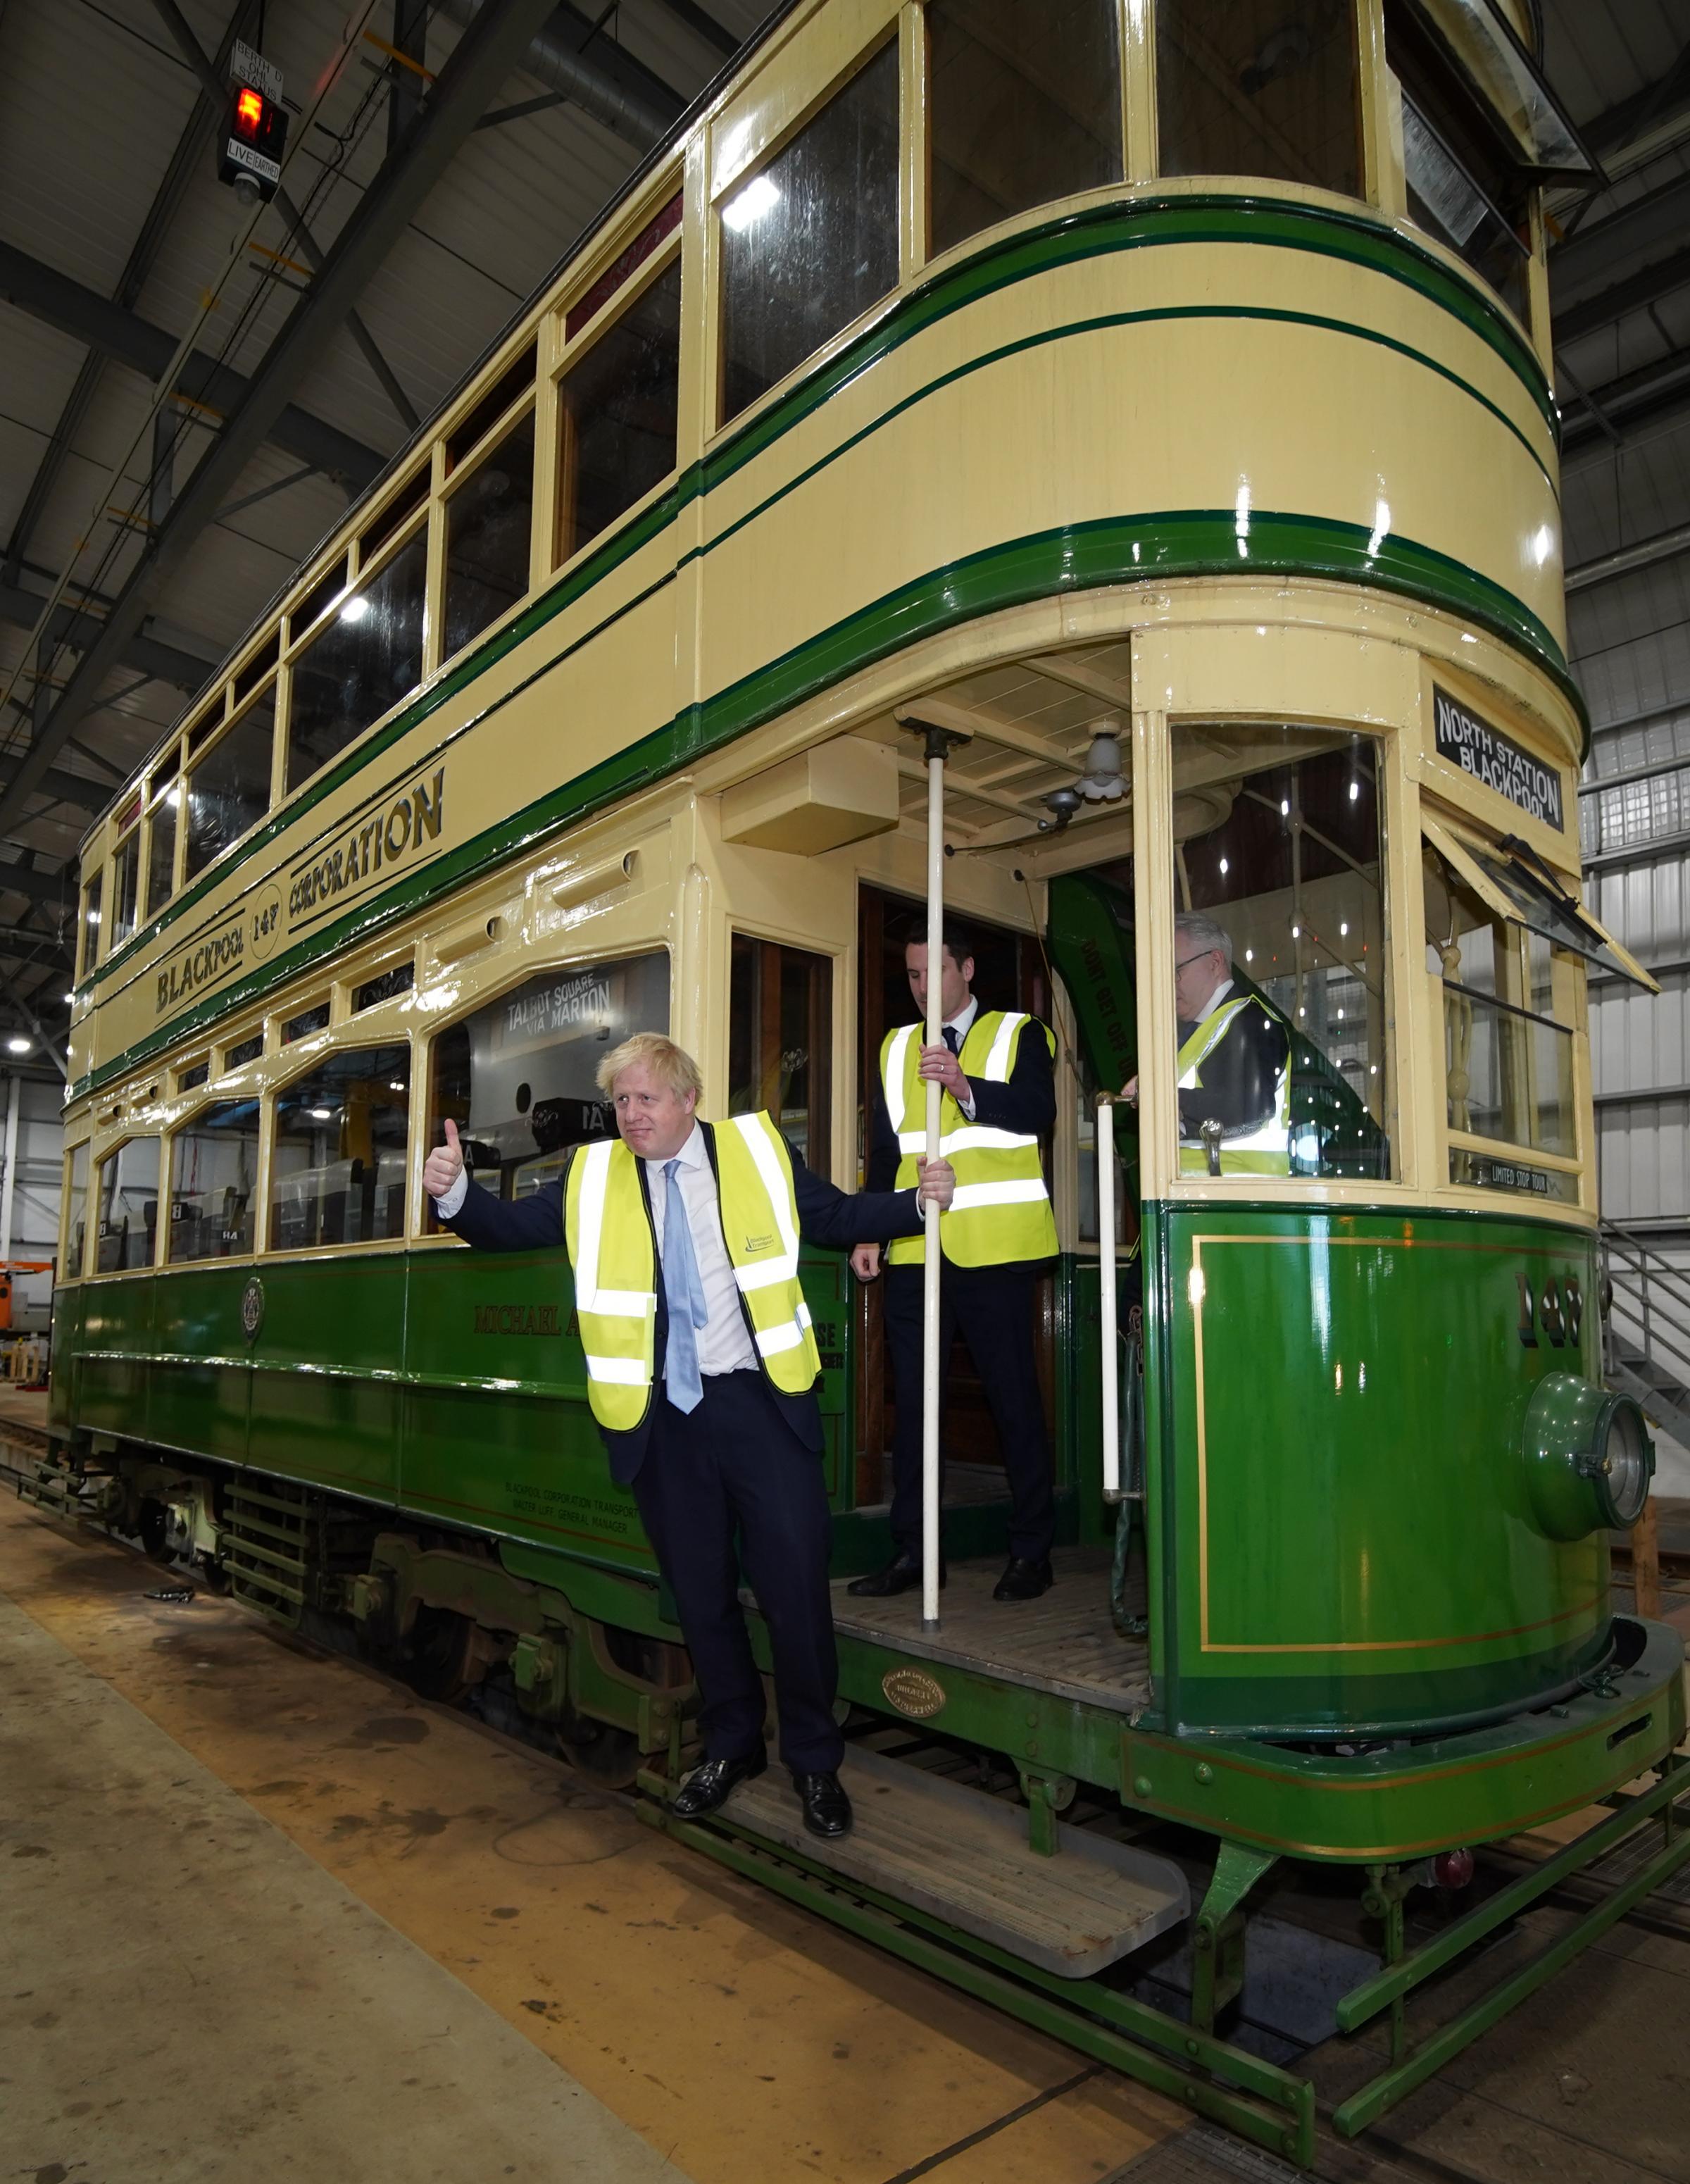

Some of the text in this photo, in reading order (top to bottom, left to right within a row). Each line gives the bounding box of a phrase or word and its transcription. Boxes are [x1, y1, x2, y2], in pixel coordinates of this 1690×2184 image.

[237, 41, 282, 82] BERTH D
[249, 62, 267, 82] OHL
[239, 66, 277, 101] STATUS
[228, 142, 254, 165] LIVE
[254, 156, 279, 179] EARTHED
[1437, 697, 1560, 823] NORTH STATION
[1460, 746, 1548, 823] BLACKPOOL
[156, 924, 244, 1014] BLACKPOOL
[289, 766, 446, 918] CORPORATION
[507, 973, 594, 1032] TALBOT SQUARE
[527, 980, 611, 1035] VIA MARTON
[1096, 987, 1118, 1019] GET
[1106, 1021, 1129, 1053] OFF
[1491, 1165, 1546, 1192] LIMITED STOP TOUR
[473, 1305, 562, 1337] MICHAEL
[505, 1481, 639, 1519] BLACKPOOL CORPORATION TRANSPORT
[512, 1499, 536, 1514] WALTER
[557, 1509, 589, 1525] GENERAL
[592, 1516, 628, 1534] MANAGER
